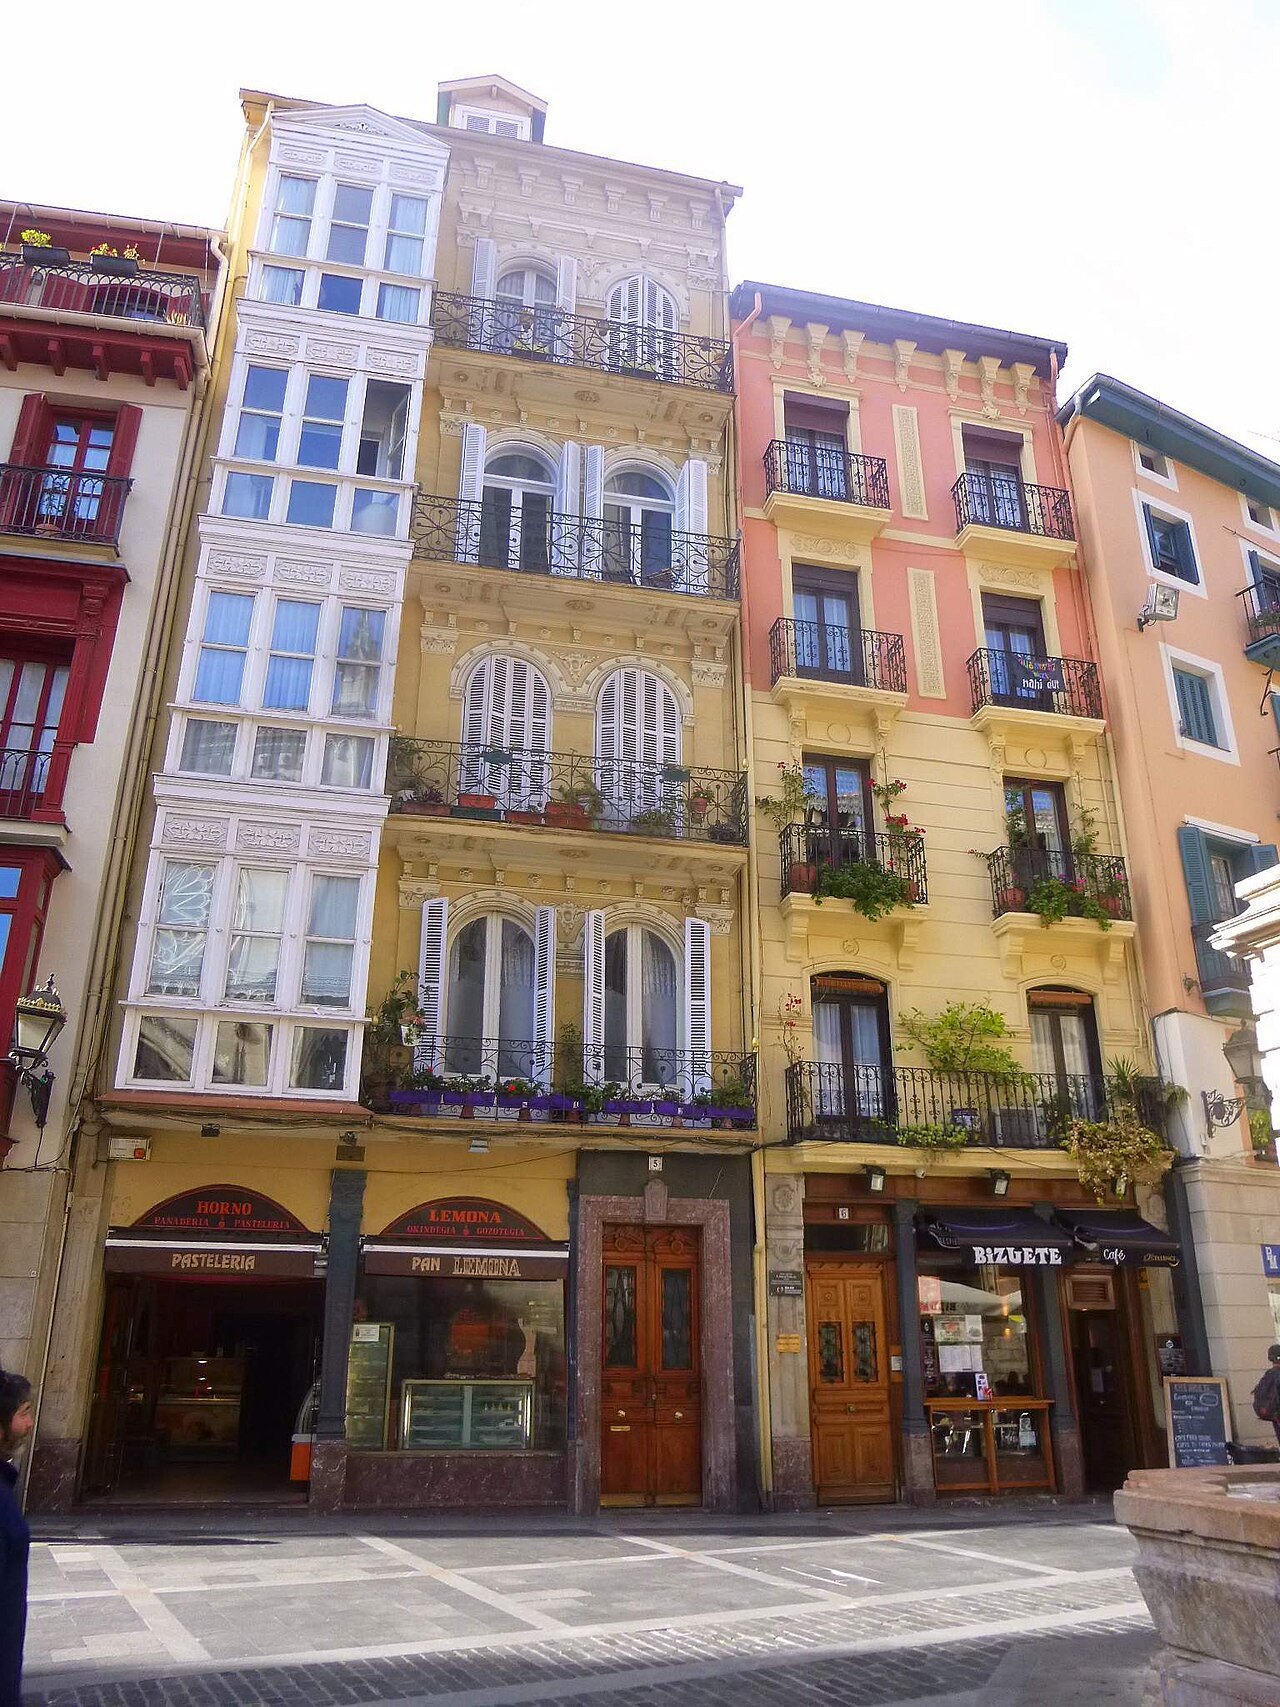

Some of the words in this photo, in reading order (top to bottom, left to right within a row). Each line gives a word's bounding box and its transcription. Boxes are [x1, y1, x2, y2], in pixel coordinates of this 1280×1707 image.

[1022, 678, 1043, 690] nahi
[1046, 679, 1060, 689] dut
[196, 1200, 253, 1216] HORNO
[429, 1209, 502, 1223] LEMONA
[154, 1216, 209, 1227] PANADERIA
[234, 1219, 290, 1229] PASTELERIA
[171, 1253, 256, 1270] PASTELERIA
[1103, 1248, 1126, 1265] Café
[411, 1256, 441, 1271] PAN
[452, 1256, 521, 1277] LEMONA
